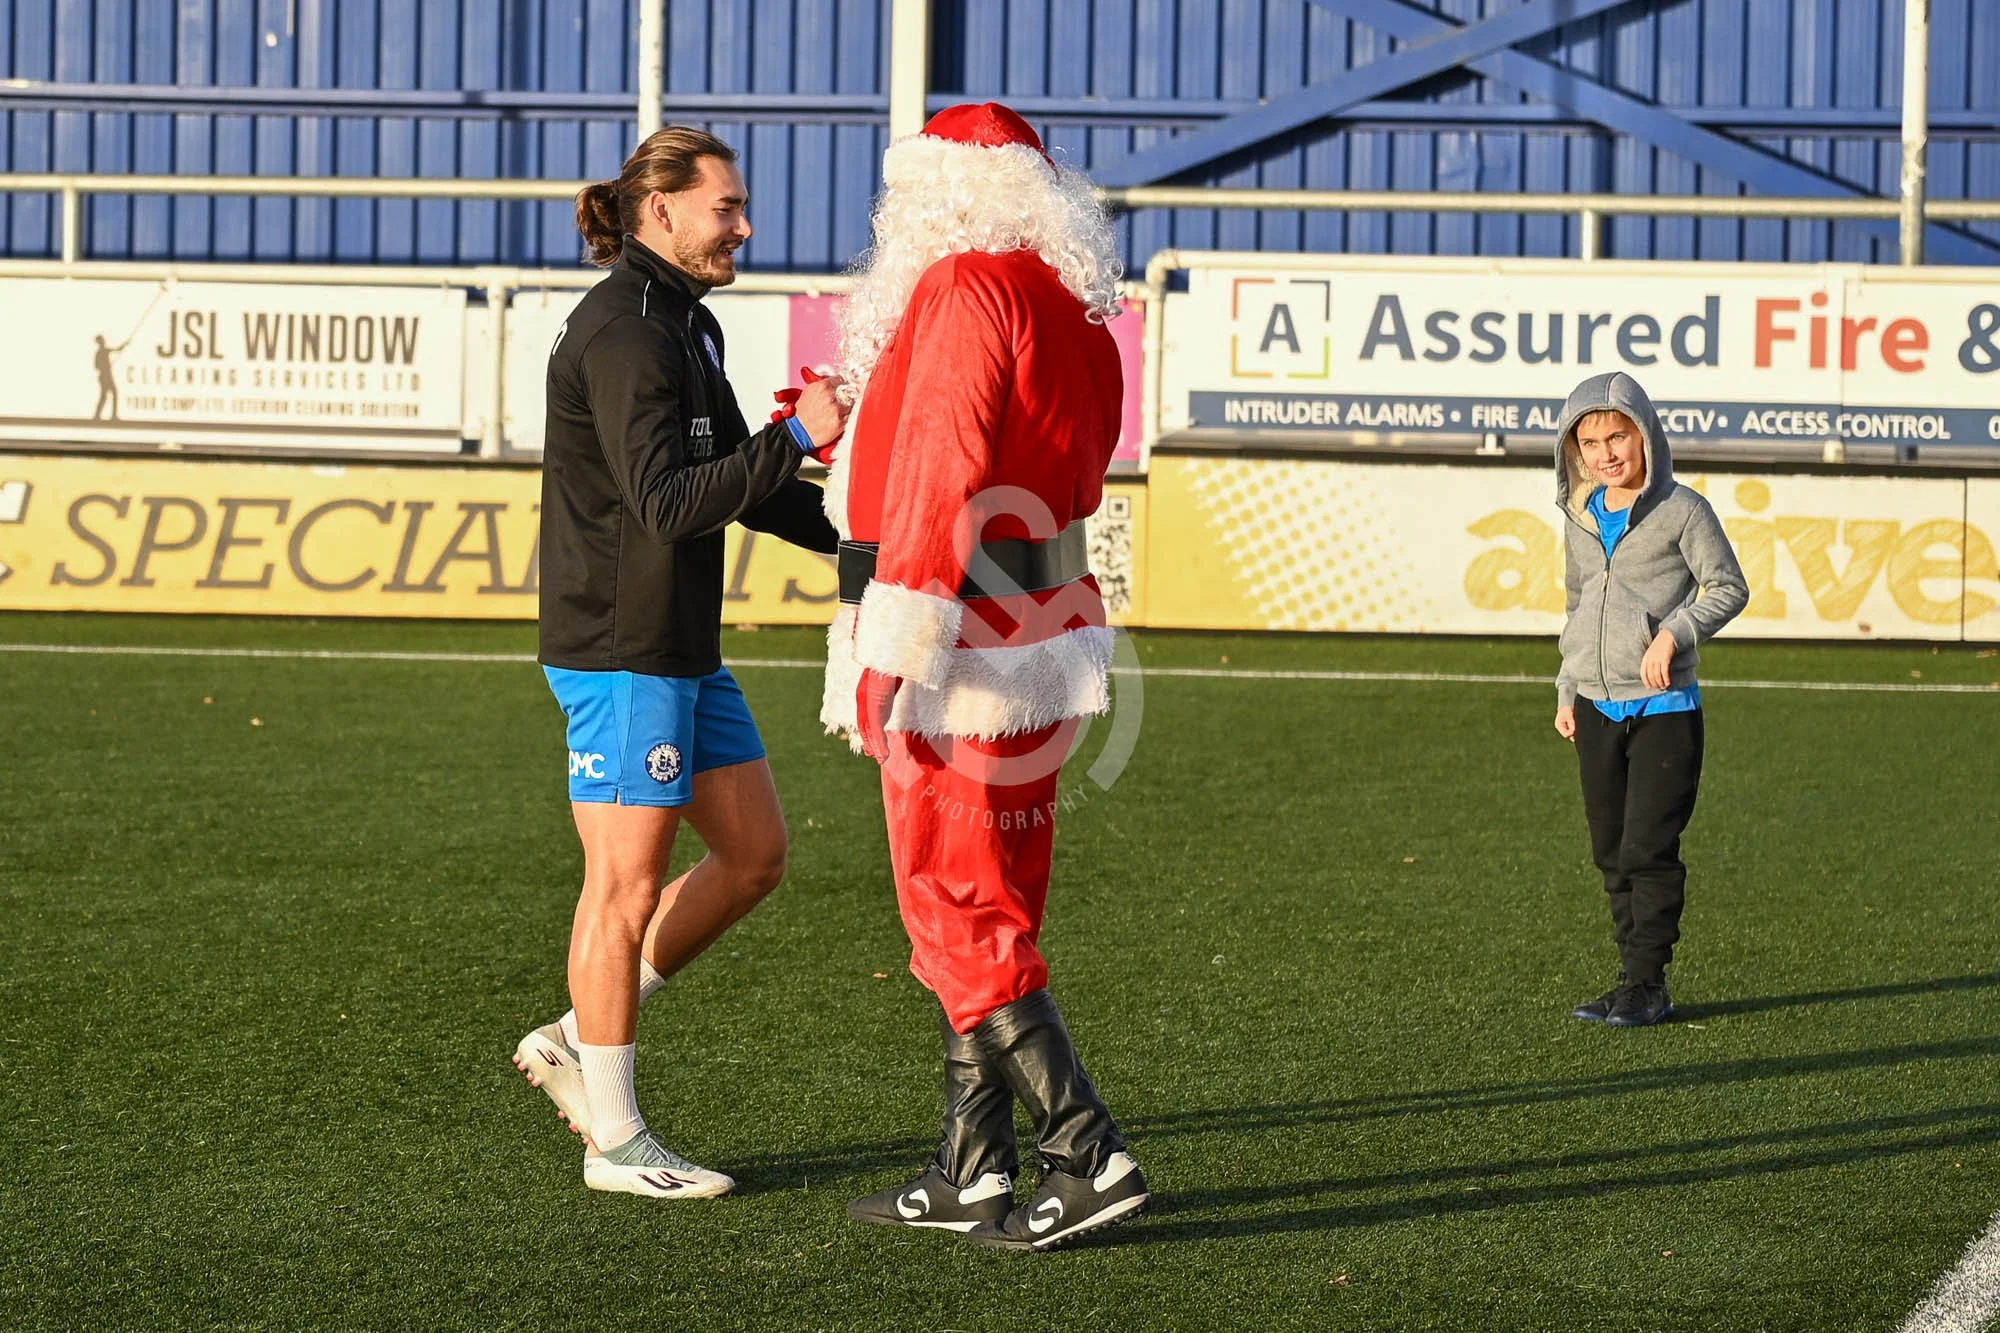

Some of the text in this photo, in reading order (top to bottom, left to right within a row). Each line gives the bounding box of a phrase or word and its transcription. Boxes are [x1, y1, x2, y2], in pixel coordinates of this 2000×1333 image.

[157, 311, 420, 365] JSL WINDOW
[1259, 303, 1301, 353] A
[1359, 291, 2000, 374] Assured Fire &
[126, 365, 421, 393] CLEANING SERVICES LTD
[126, 396, 157, 411] YOUR
[296, 400, 354, 417] CLEANING
[1225, 400, 1340, 426] INTRUDER
[1345, 402, 1445, 428] ALARMS
[1471, 405, 1519, 430] FIRE
[1741, 410, 1830, 436] ACCESS
[1835, 412, 1951, 440] CONTROL
[1463, 478, 2000, 625] aive
